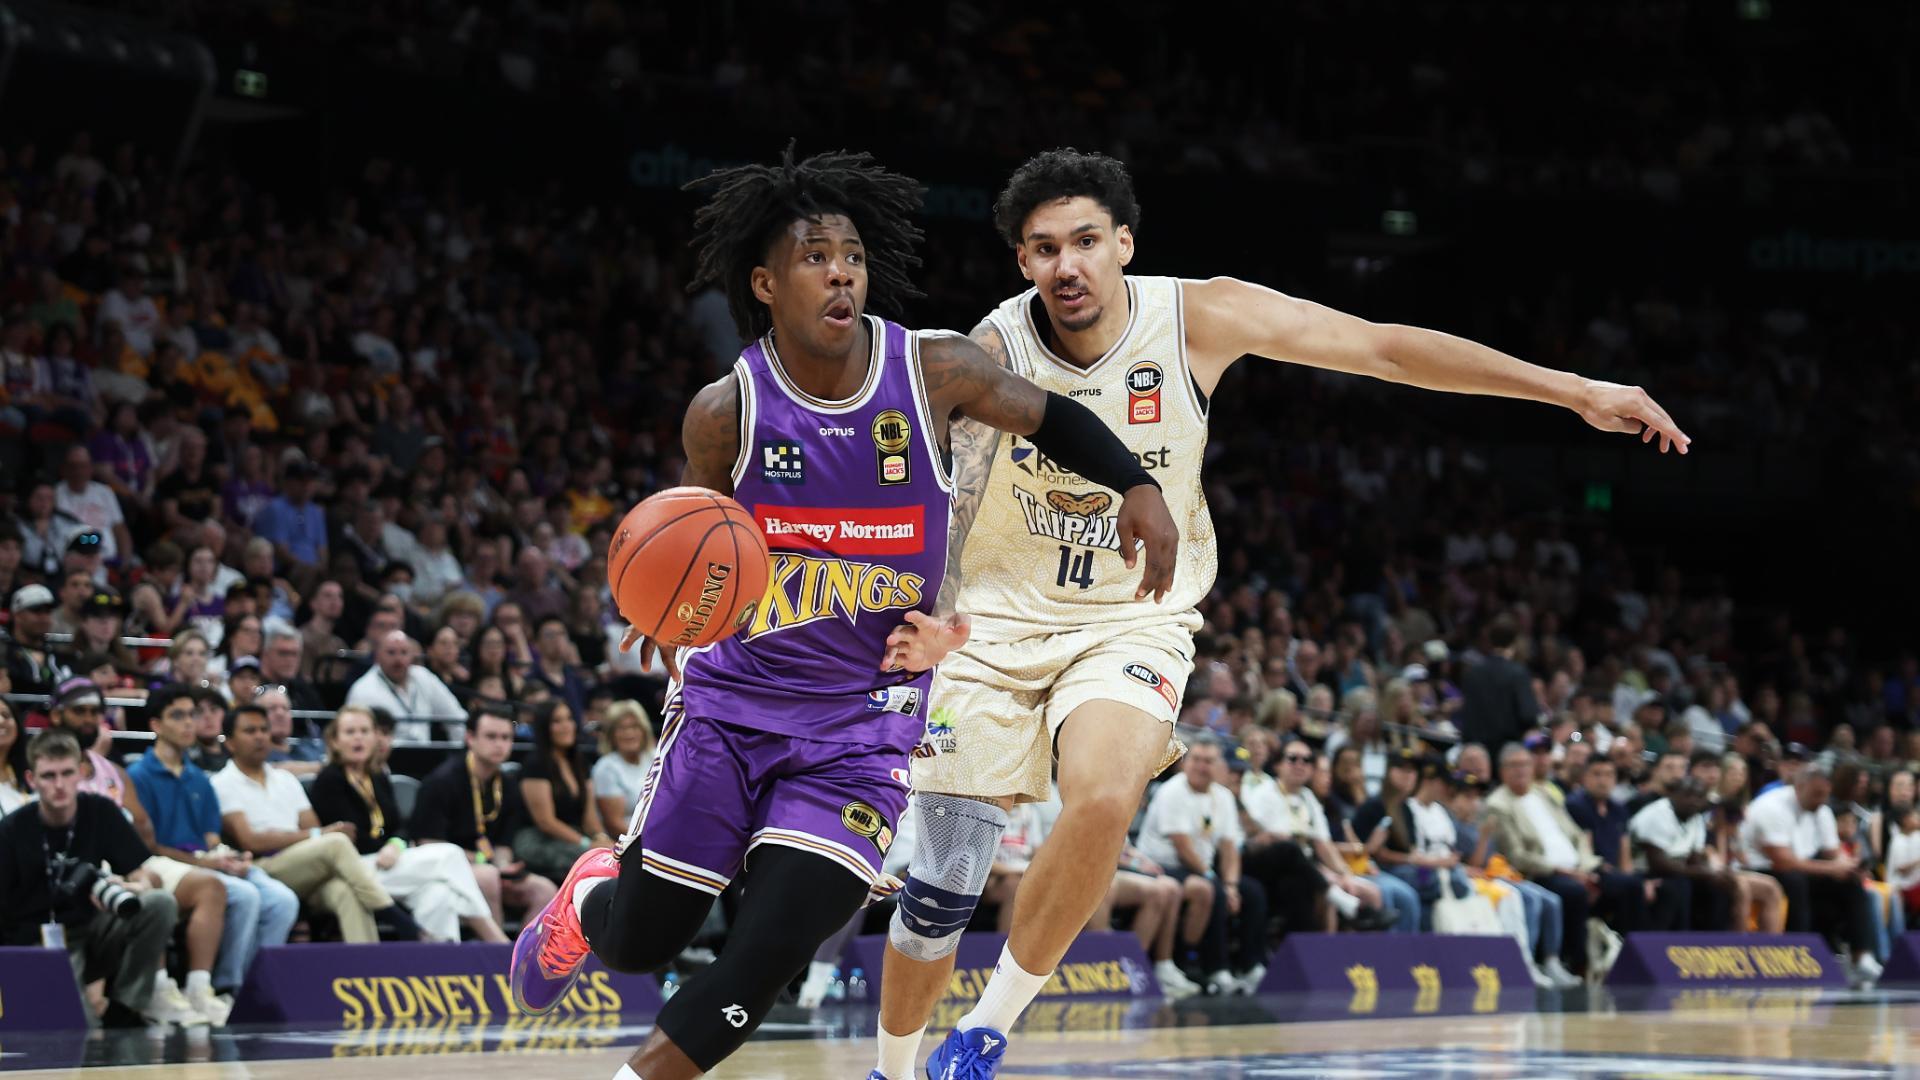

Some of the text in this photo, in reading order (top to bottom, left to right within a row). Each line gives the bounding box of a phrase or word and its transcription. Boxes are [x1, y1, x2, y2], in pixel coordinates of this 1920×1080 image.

[1133, 371, 1155, 388] NBL
[1068, 388, 1102, 398] OPTUS
[819, 427, 855, 437] OPTUS
[880, 422, 903, 441] NBL
[764, 470, 802, 479] HOSTPLUS
[764, 517, 915, 543] Harvey Norman
[1013, 484, 1144, 558] TAIPAN
[1056, 545, 1094, 589] 14
[741, 552, 925, 643] KINGS
[1130, 665, 1153, 683] NBL
[850, 808, 873, 829] NBL
[332, 975, 491, 1020] SYDNEY
